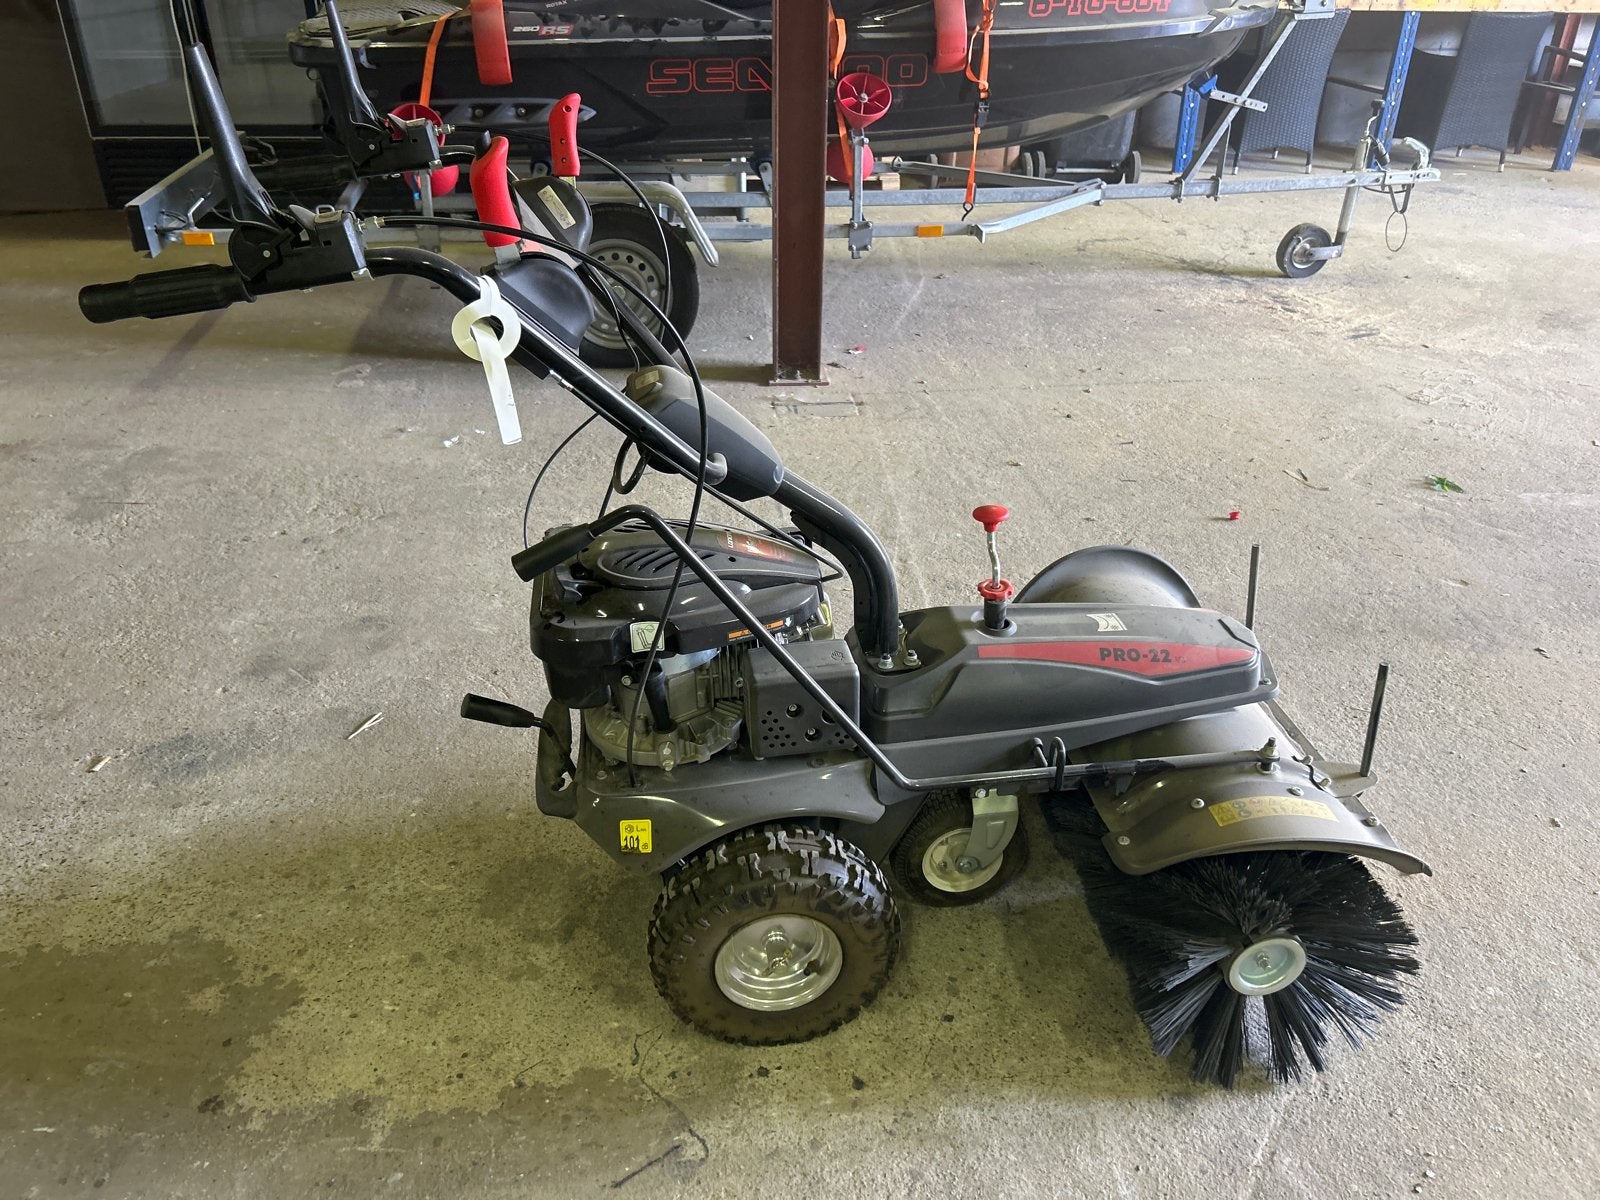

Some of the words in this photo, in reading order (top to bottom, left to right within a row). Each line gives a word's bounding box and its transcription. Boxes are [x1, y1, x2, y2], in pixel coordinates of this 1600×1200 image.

[540, 25, 571, 35] RS
[1099, 647, 1172, 663] PRO-22
[623, 835, 640, 850] 101
